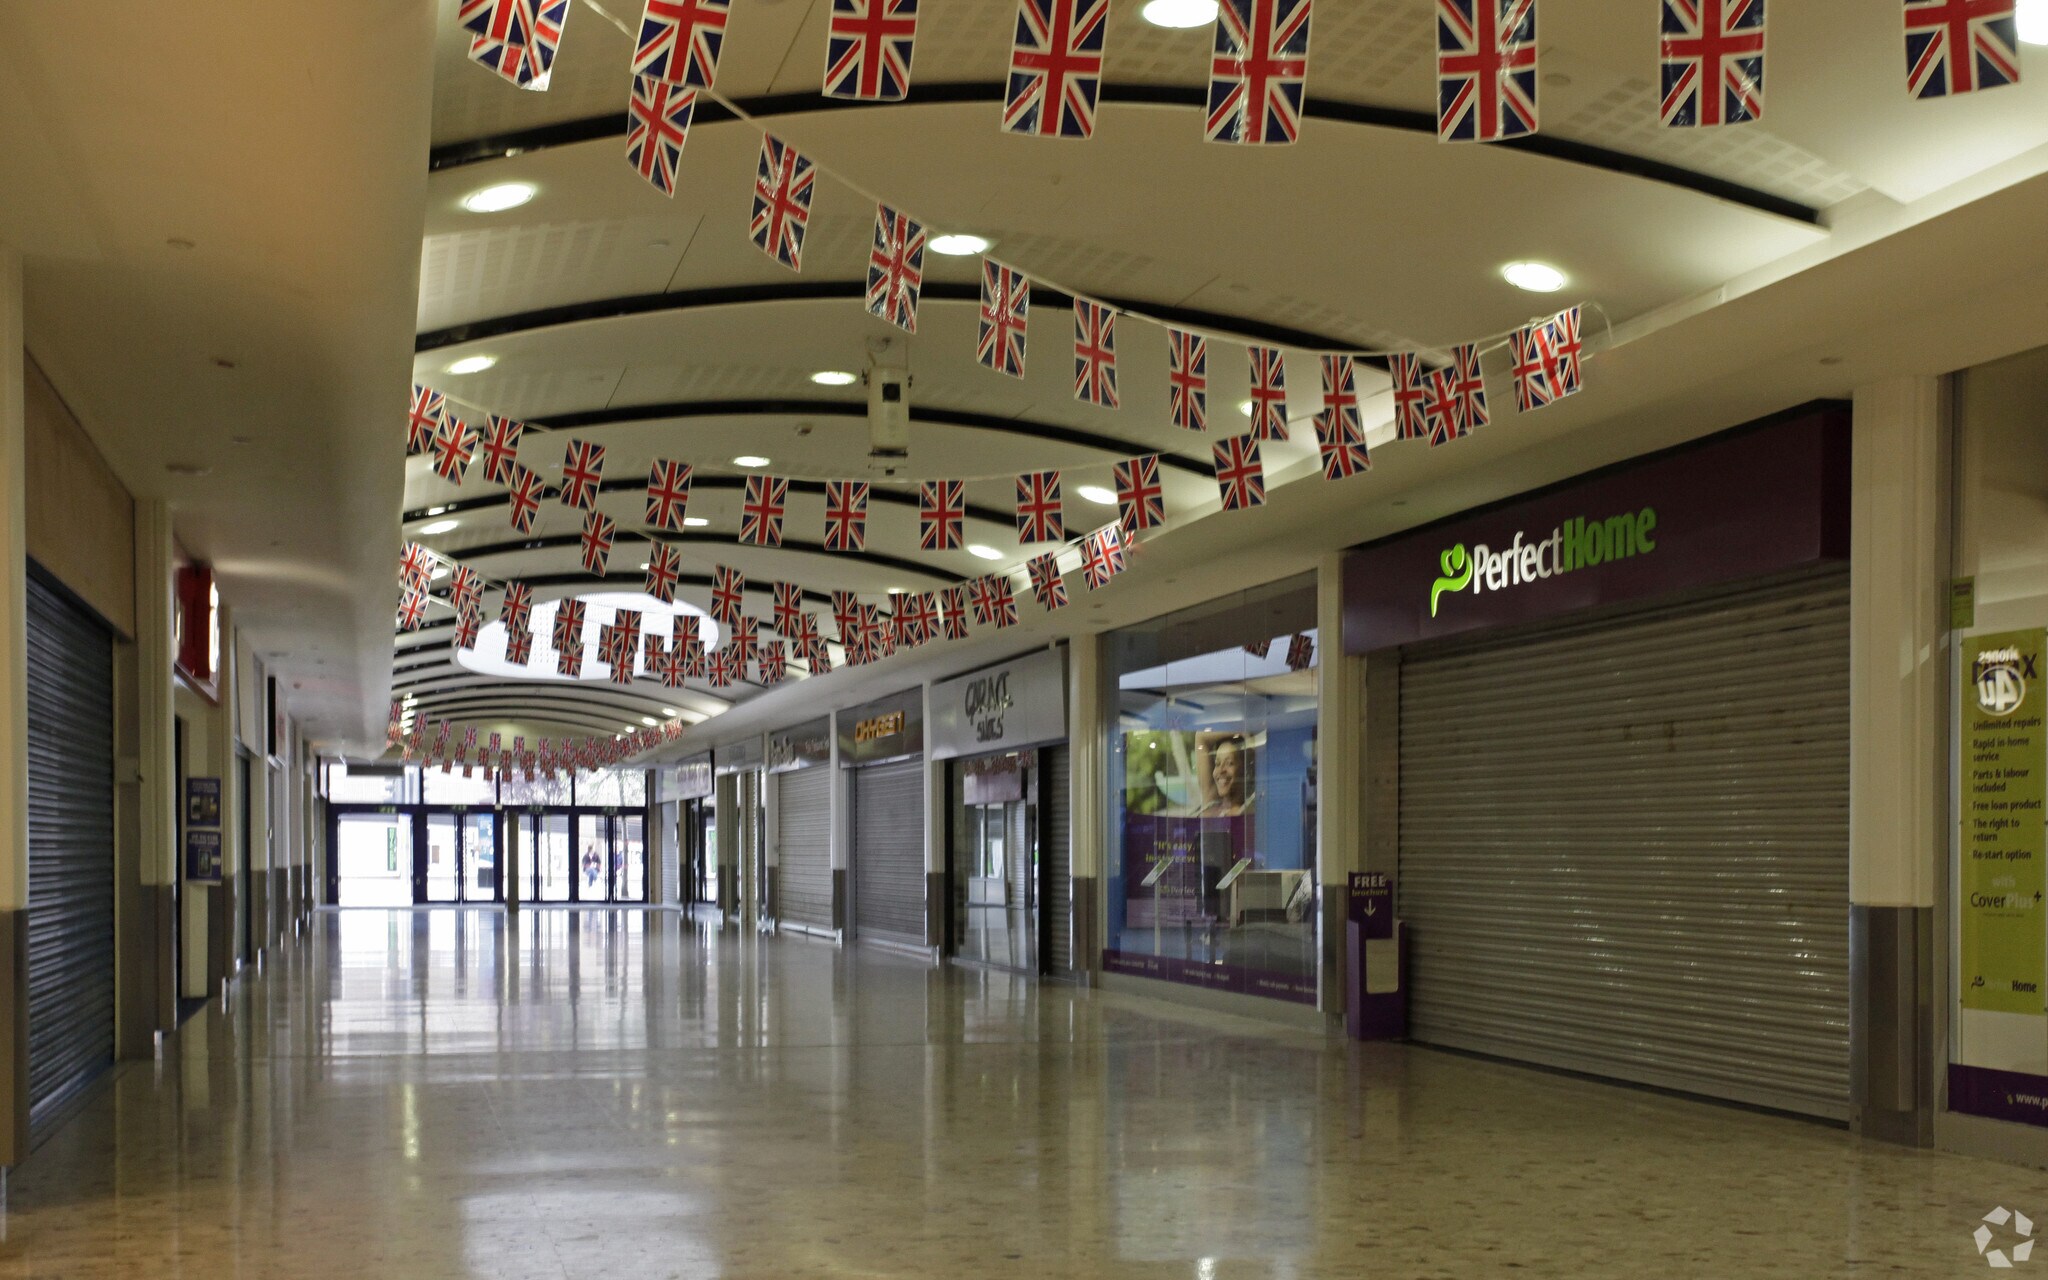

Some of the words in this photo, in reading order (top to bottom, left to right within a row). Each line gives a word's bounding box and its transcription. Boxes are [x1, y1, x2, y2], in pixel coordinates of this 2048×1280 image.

[1473, 507, 1657, 594] PerfectHome
[1973, 718, 2011, 731] Unlimited
[2013, 716, 2041, 730] repairs
[1973, 738, 1995, 750] Rapid
[1973, 752, 1999, 762] service
[1973, 770, 1993, 780] Parts
[2003, 768, 2029, 779] labour
[1973, 782, 2006, 793] included
[1973, 801, 1989, 811] Free
[1991, 800, 2008, 810] loan
[2010, 799, 2041, 812] product
[1974, 819, 1987, 829] The
[1989, 818, 2008, 831] right
[2011, 818, 2020, 828] to
[1973, 833, 1997, 842] return
[1973, 850, 2003, 860] Re-start
[2005, 849, 2031, 863] option
[1354, 875, 1387, 888] FREE
